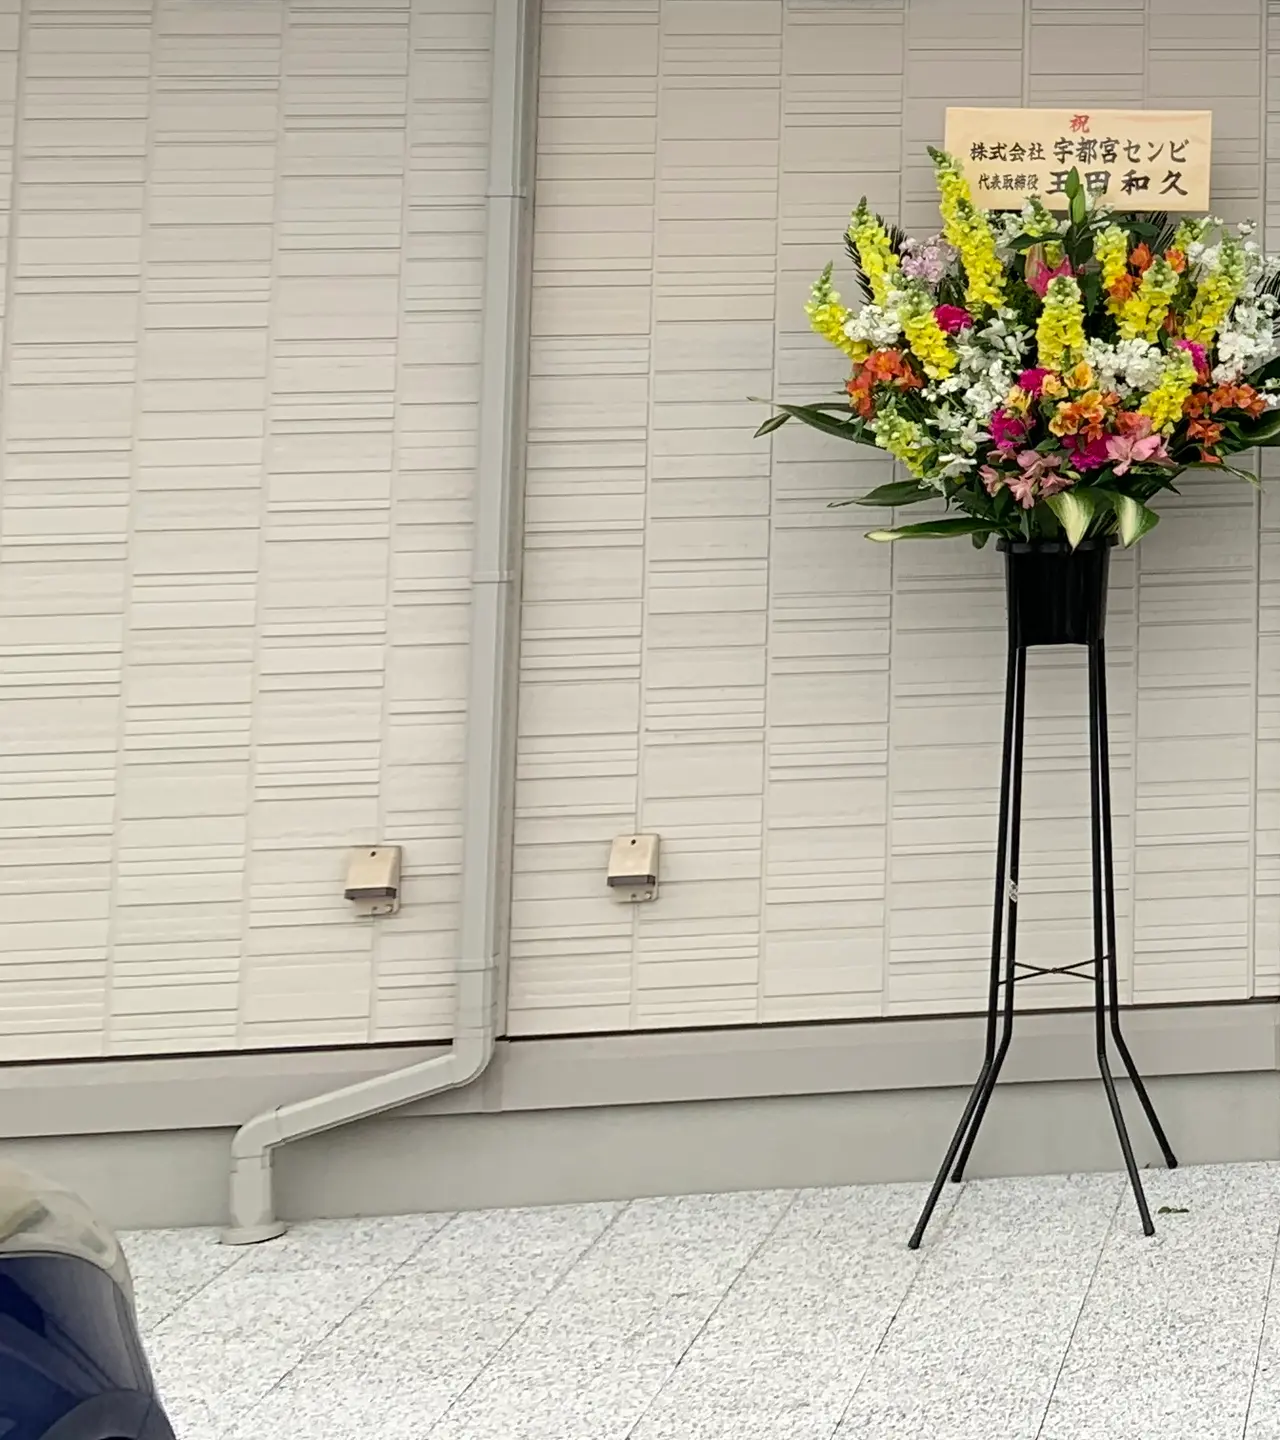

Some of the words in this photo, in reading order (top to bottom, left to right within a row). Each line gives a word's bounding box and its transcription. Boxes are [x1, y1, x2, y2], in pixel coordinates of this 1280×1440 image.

[1069, 114, 1091, 133] 祝
[970, 141, 1046, 163] 株式会社
[1052, 136, 1190, 165] 宇都宮センビ
[977, 173, 1039, 191] 代表取締役
